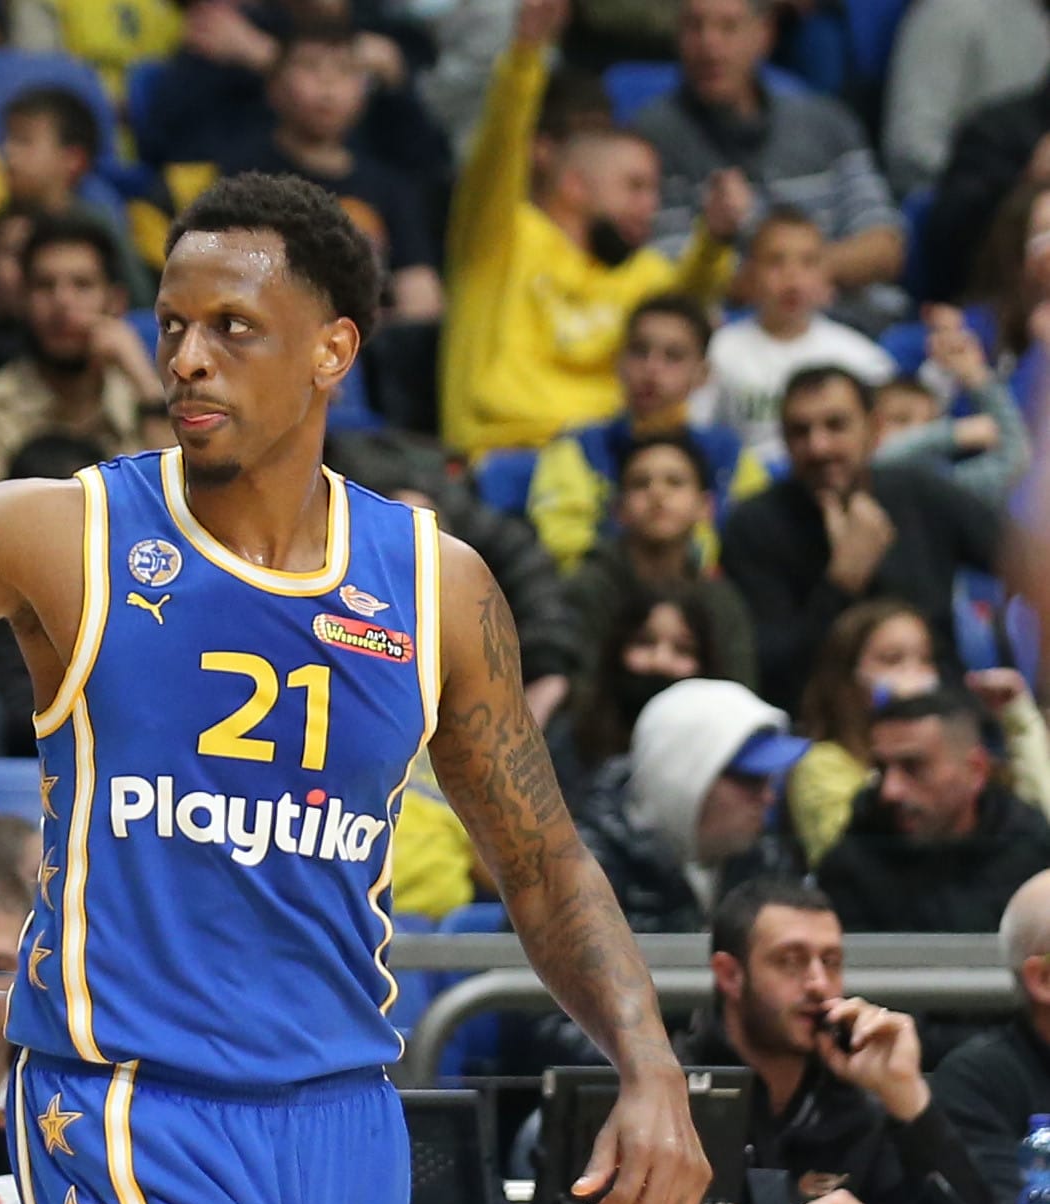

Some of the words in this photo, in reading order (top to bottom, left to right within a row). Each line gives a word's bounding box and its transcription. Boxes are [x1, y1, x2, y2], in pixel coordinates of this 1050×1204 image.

[325, 622, 386, 652] Winner
[197, 651, 331, 771] 21
[110, 775, 387, 867] Playtika
